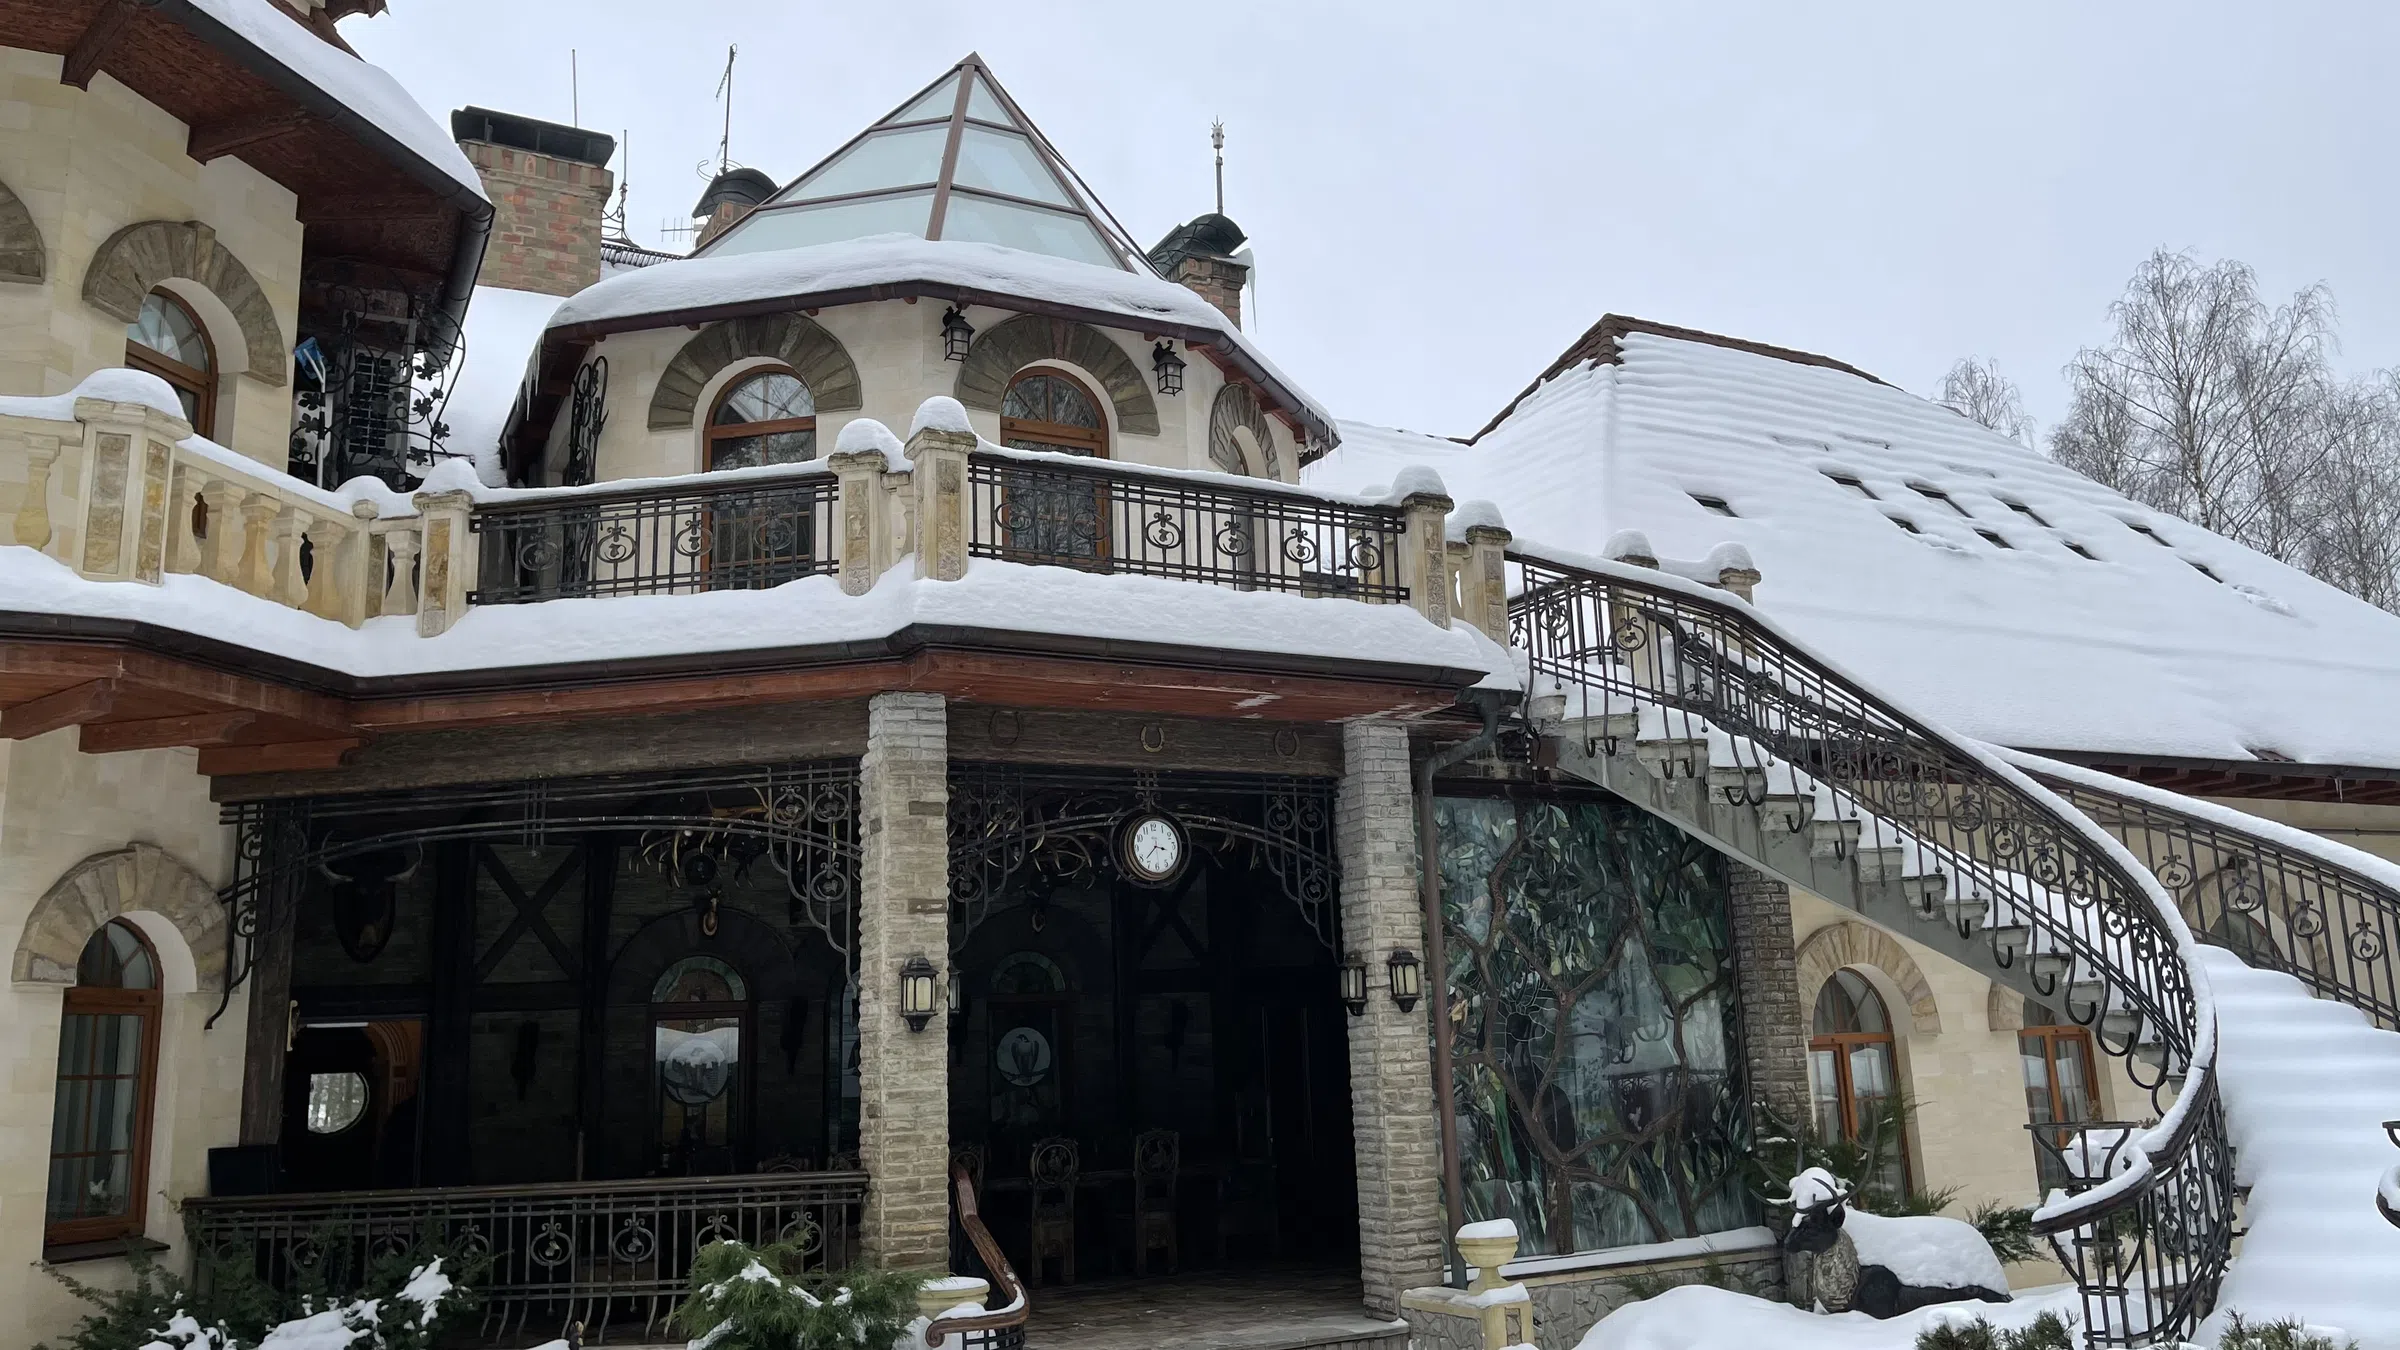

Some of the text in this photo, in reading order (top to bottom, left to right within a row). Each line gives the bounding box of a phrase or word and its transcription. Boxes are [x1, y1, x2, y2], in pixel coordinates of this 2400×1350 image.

[1143, 827, 1148, 835] 11
[1150, 823, 1156, 831] 12
[1137, 834, 1143, 842] 10
[1172, 842, 1176, 850] 3
[1147, 861, 1151, 869] 7
[1164, 860, 1168, 868] 5
